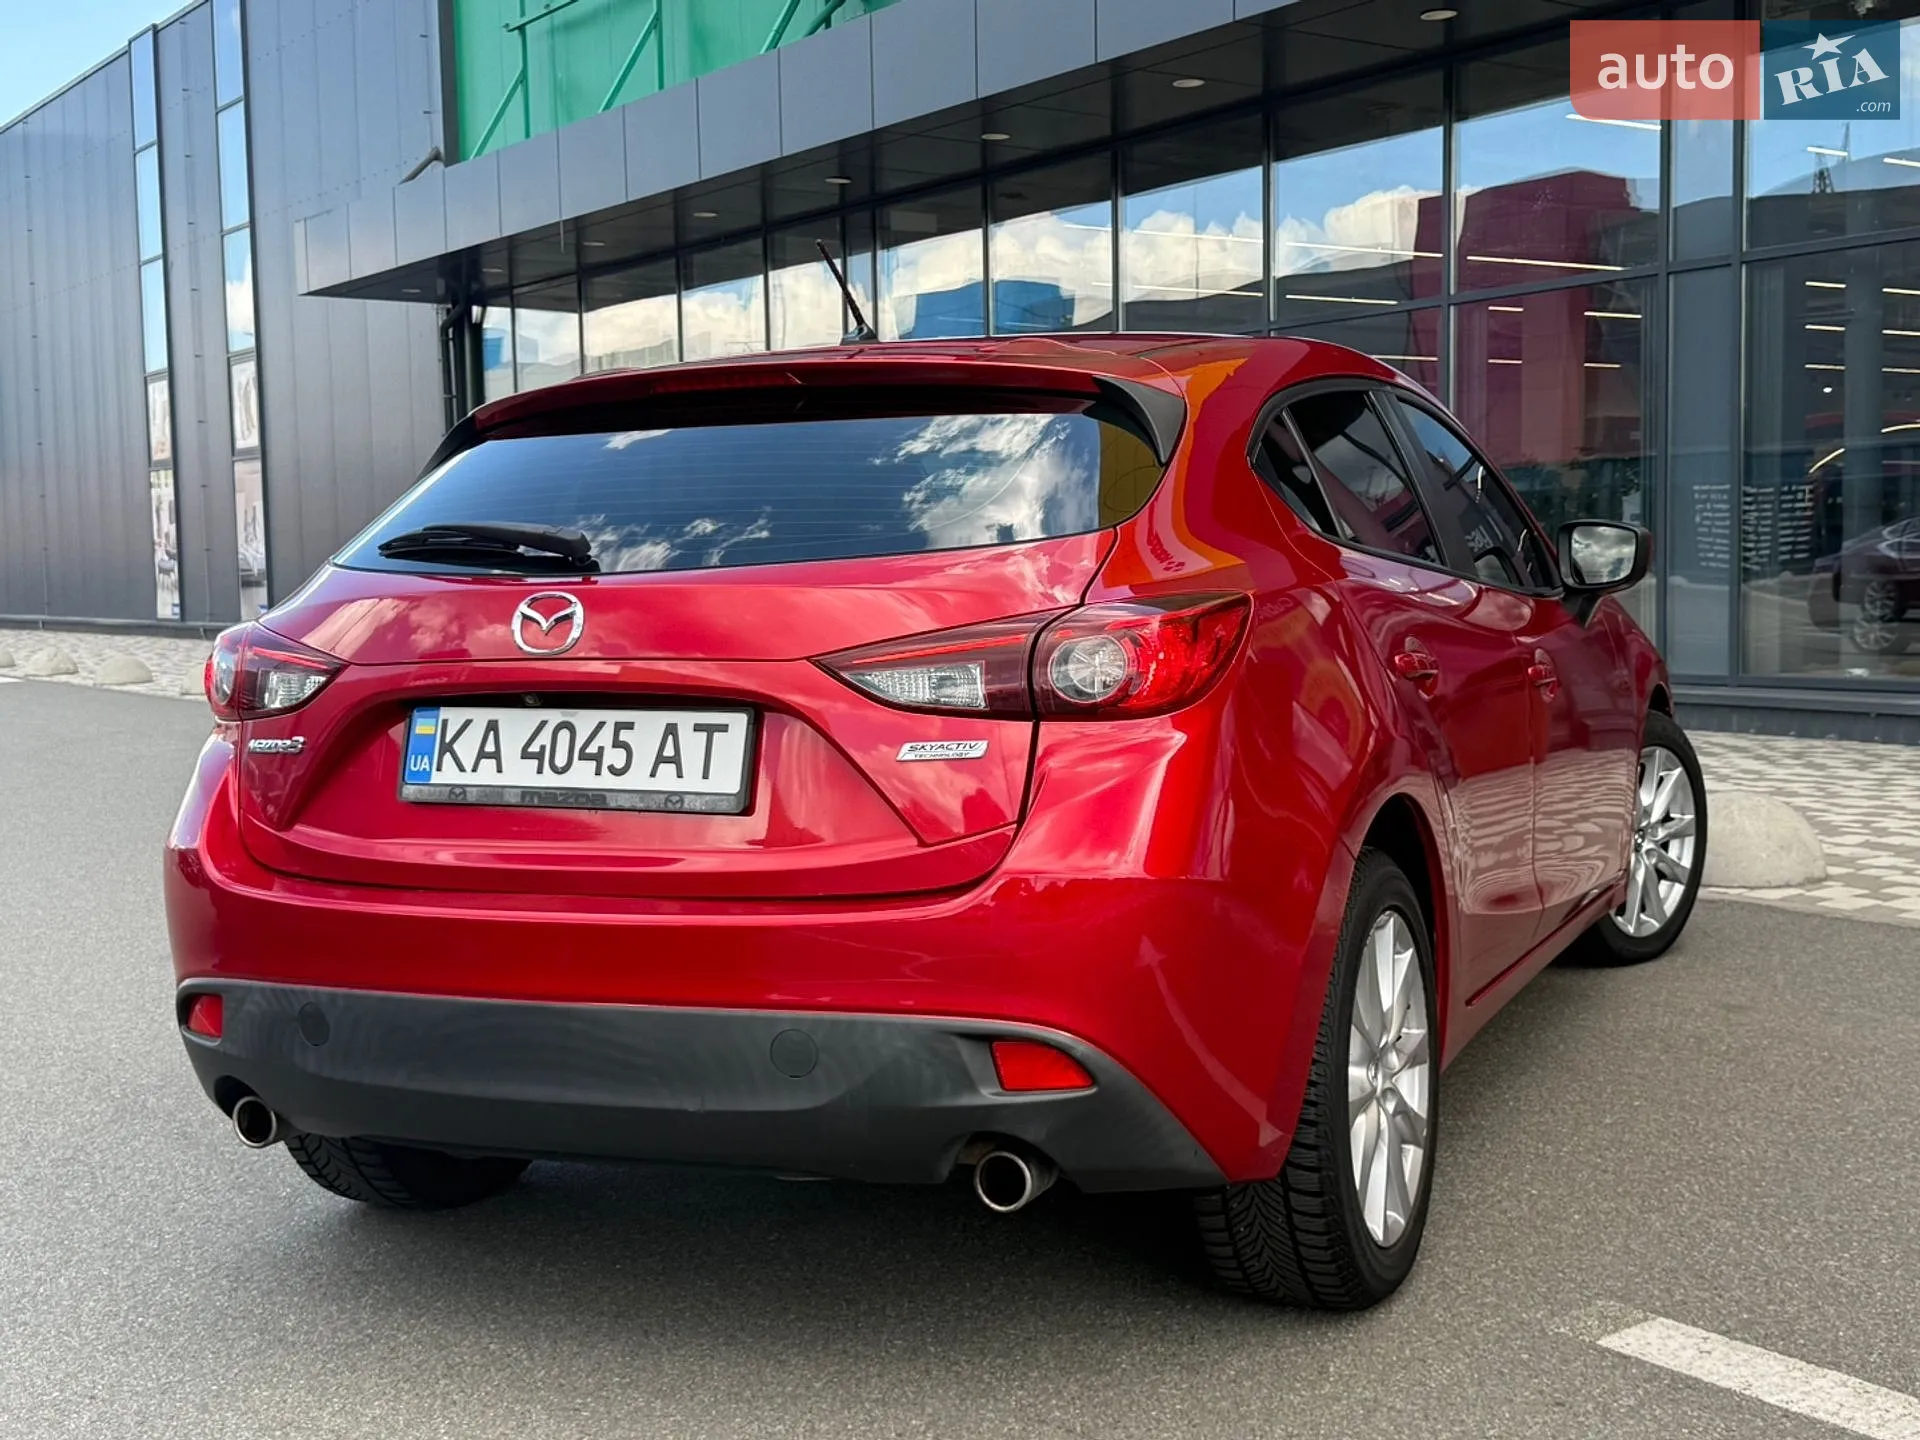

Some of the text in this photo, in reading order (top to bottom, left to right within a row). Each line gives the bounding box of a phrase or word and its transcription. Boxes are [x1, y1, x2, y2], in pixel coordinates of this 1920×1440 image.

[436, 718, 730, 780] KA 4045 AT
[907, 742, 979, 752] SKYACTIV
[410, 751, 431, 772] UA
